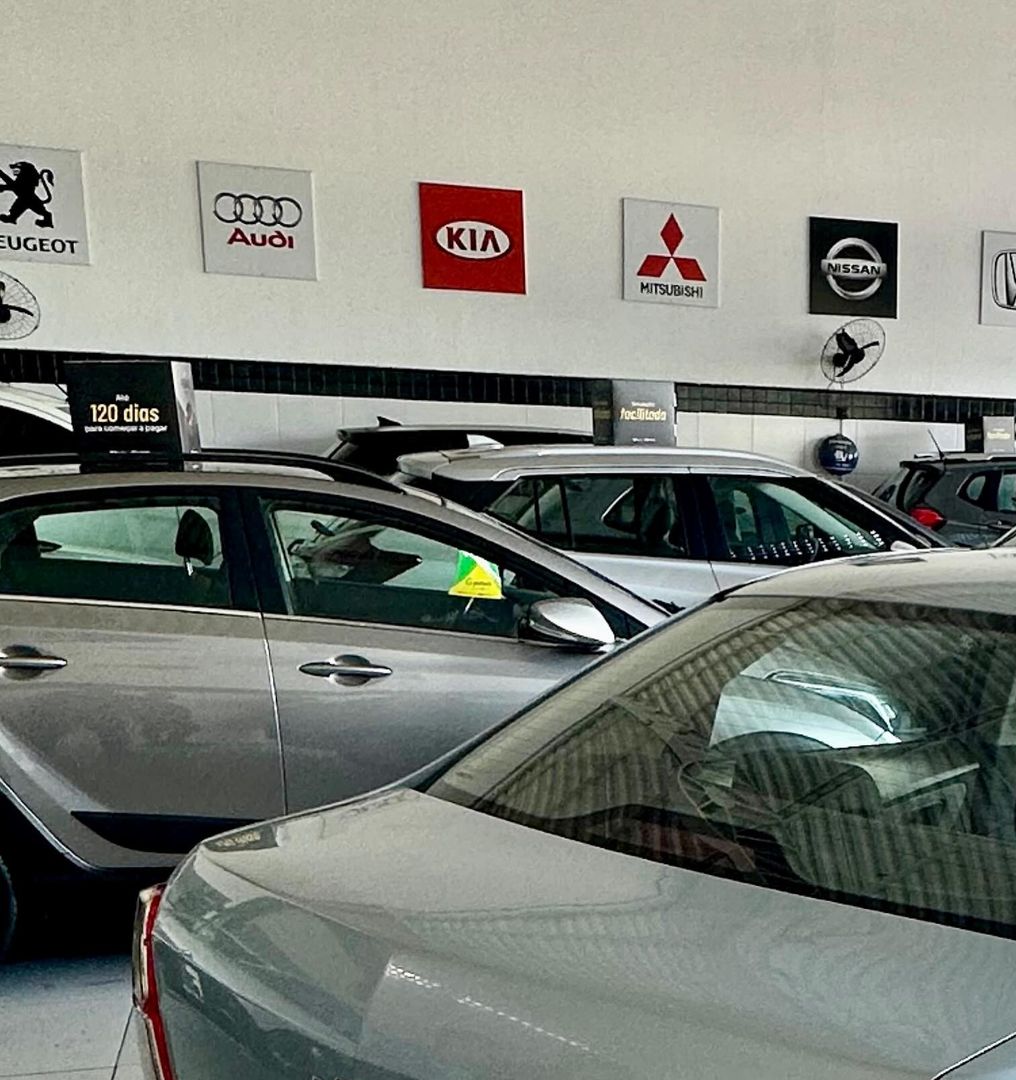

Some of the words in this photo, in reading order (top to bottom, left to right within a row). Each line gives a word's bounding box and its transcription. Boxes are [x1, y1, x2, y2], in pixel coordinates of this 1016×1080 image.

[227, 227, 294, 249] Audi
[446, 226, 501, 252] KIA
[827, 262, 881, 275] NISSAN
[640, 281, 703, 299] MITSUBISHI
[89, 403, 119, 423] 120
[123, 402, 160, 423] dias
